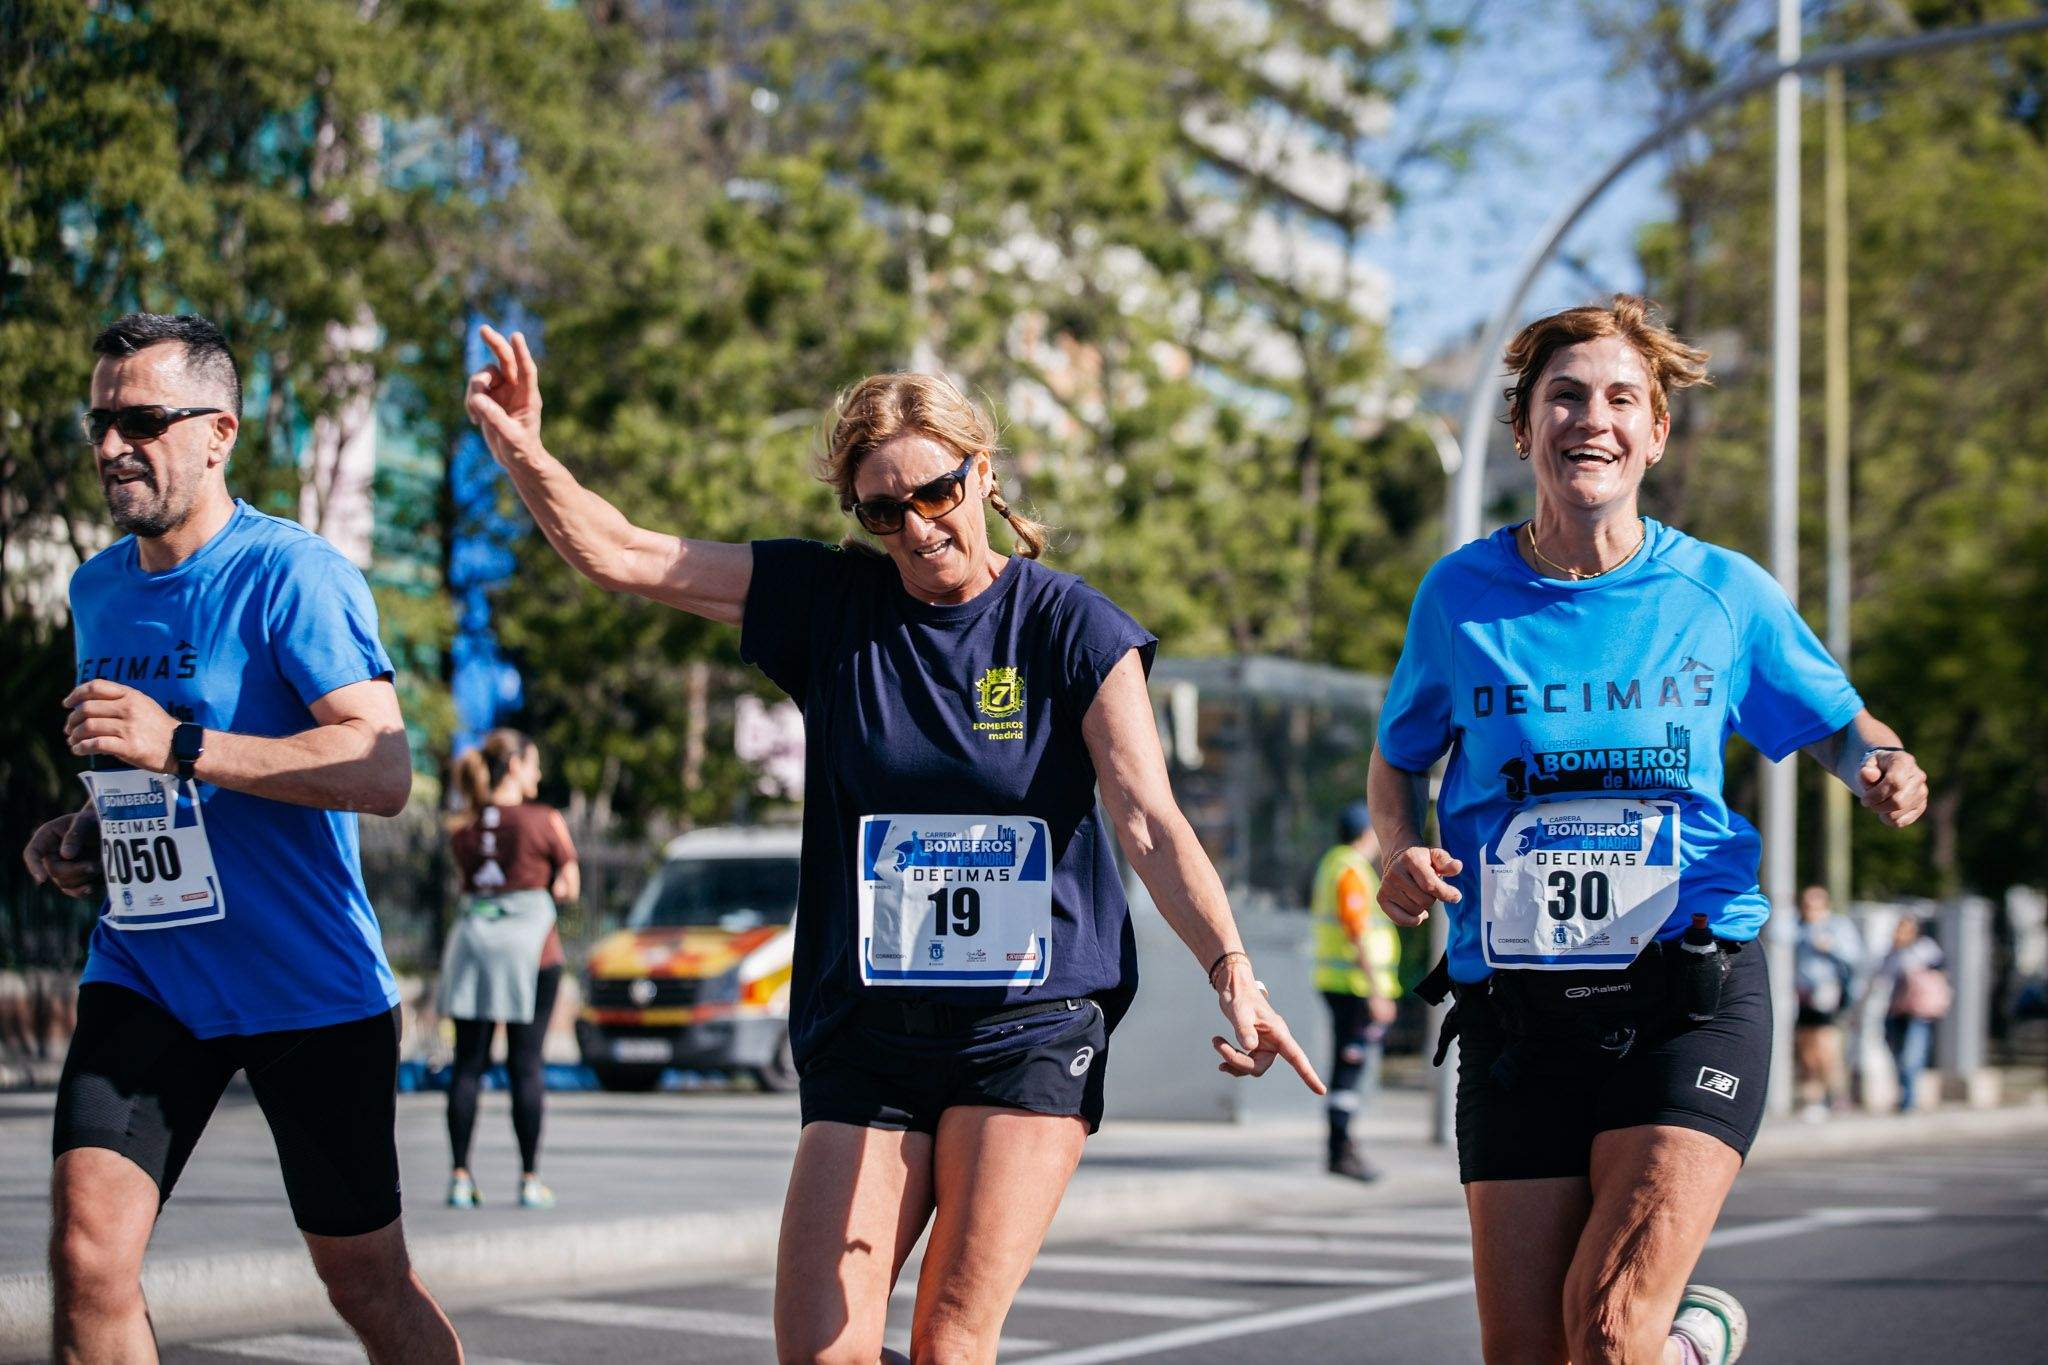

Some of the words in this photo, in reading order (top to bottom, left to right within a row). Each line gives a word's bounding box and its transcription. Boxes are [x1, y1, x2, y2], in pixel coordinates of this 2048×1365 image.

[79, 655, 198, 682] ECIMAS
[1473, 675, 1715, 718] DECIMAS
[973, 721, 1024, 731] BOMBEROS
[988, 730, 1024, 740] madrid
[1543, 748, 1687, 773] BOMBEROS
[1603, 770, 1623, 789] de
[1628, 768, 1689, 789] MADRID
[104, 792, 165, 807] BOMBEROS
[1549, 815, 1582, 823] CARRERA
[105, 819, 167, 835] DECIMAS
[1547, 823, 1640, 837] BOMBEROS
[924, 831, 958, 839] CARRERA
[924, 840, 1013, 854] BOMBEROS
[1581, 836, 1595, 849] de
[1598, 836, 1640, 850] MADRID
[102, 835, 183, 885] 2050
[957, 852, 971, 865] de
[973, 853, 1013, 866] MADRID
[1536, 852, 1637, 866] DECIMAS
[913, 868, 1011, 882] DECIMAS
[1547, 870, 1610, 921] 30
[927, 887, 981, 937] 19
[1591, 983, 1632, 993] Kalenji
